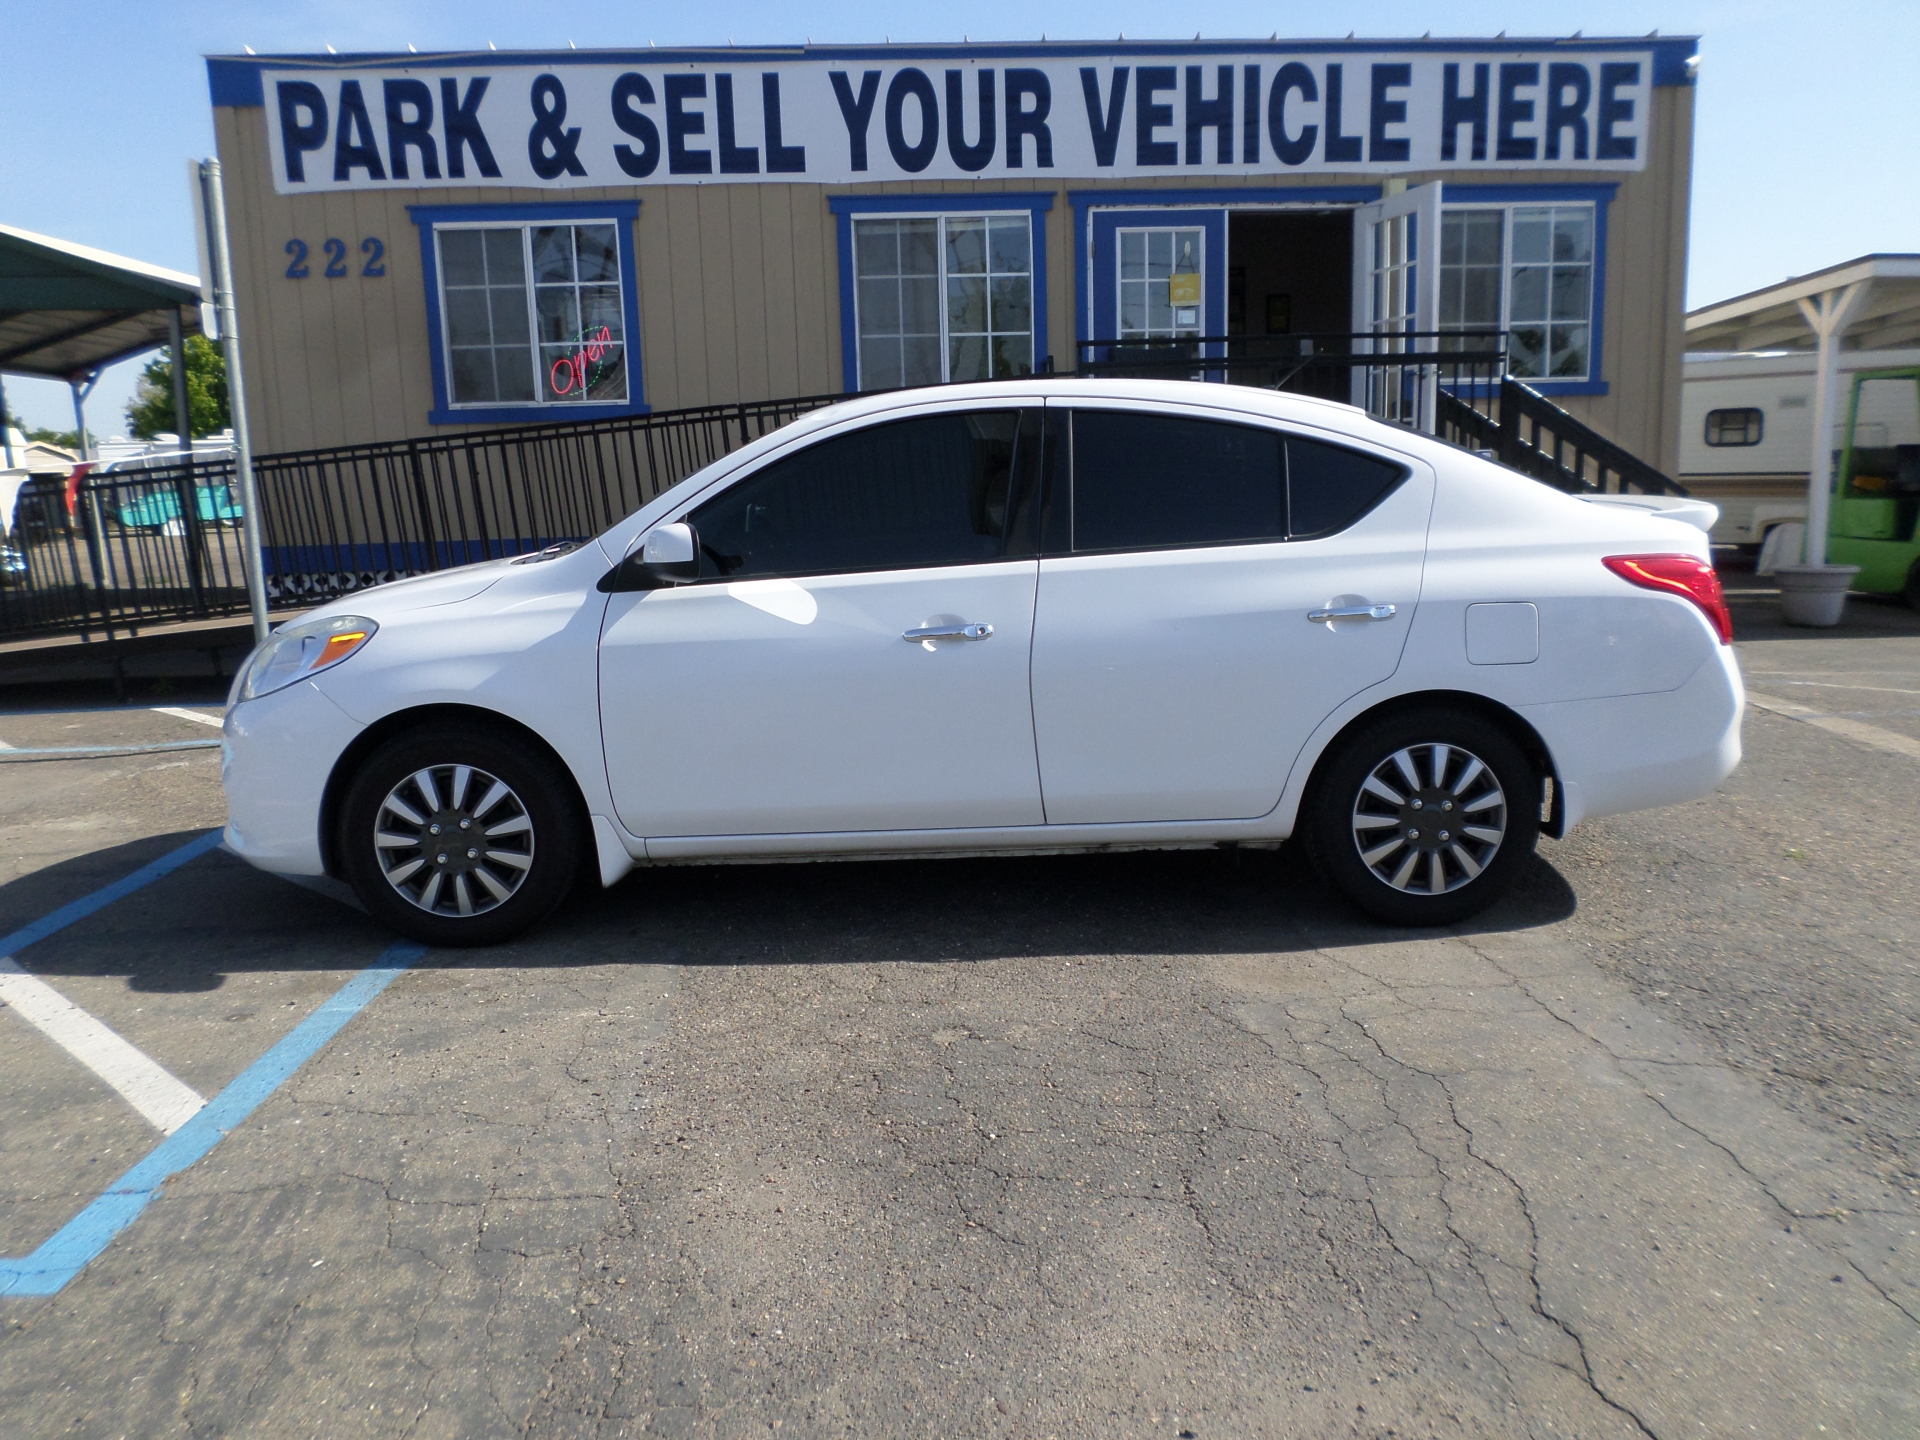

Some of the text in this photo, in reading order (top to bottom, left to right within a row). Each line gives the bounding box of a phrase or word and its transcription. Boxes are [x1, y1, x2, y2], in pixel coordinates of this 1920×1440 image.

[275, 61, 1641, 183] PARK & SELL YOUR VEHICLE HERE
[285, 236, 386, 279] 222
[550, 325, 613, 395] Open
